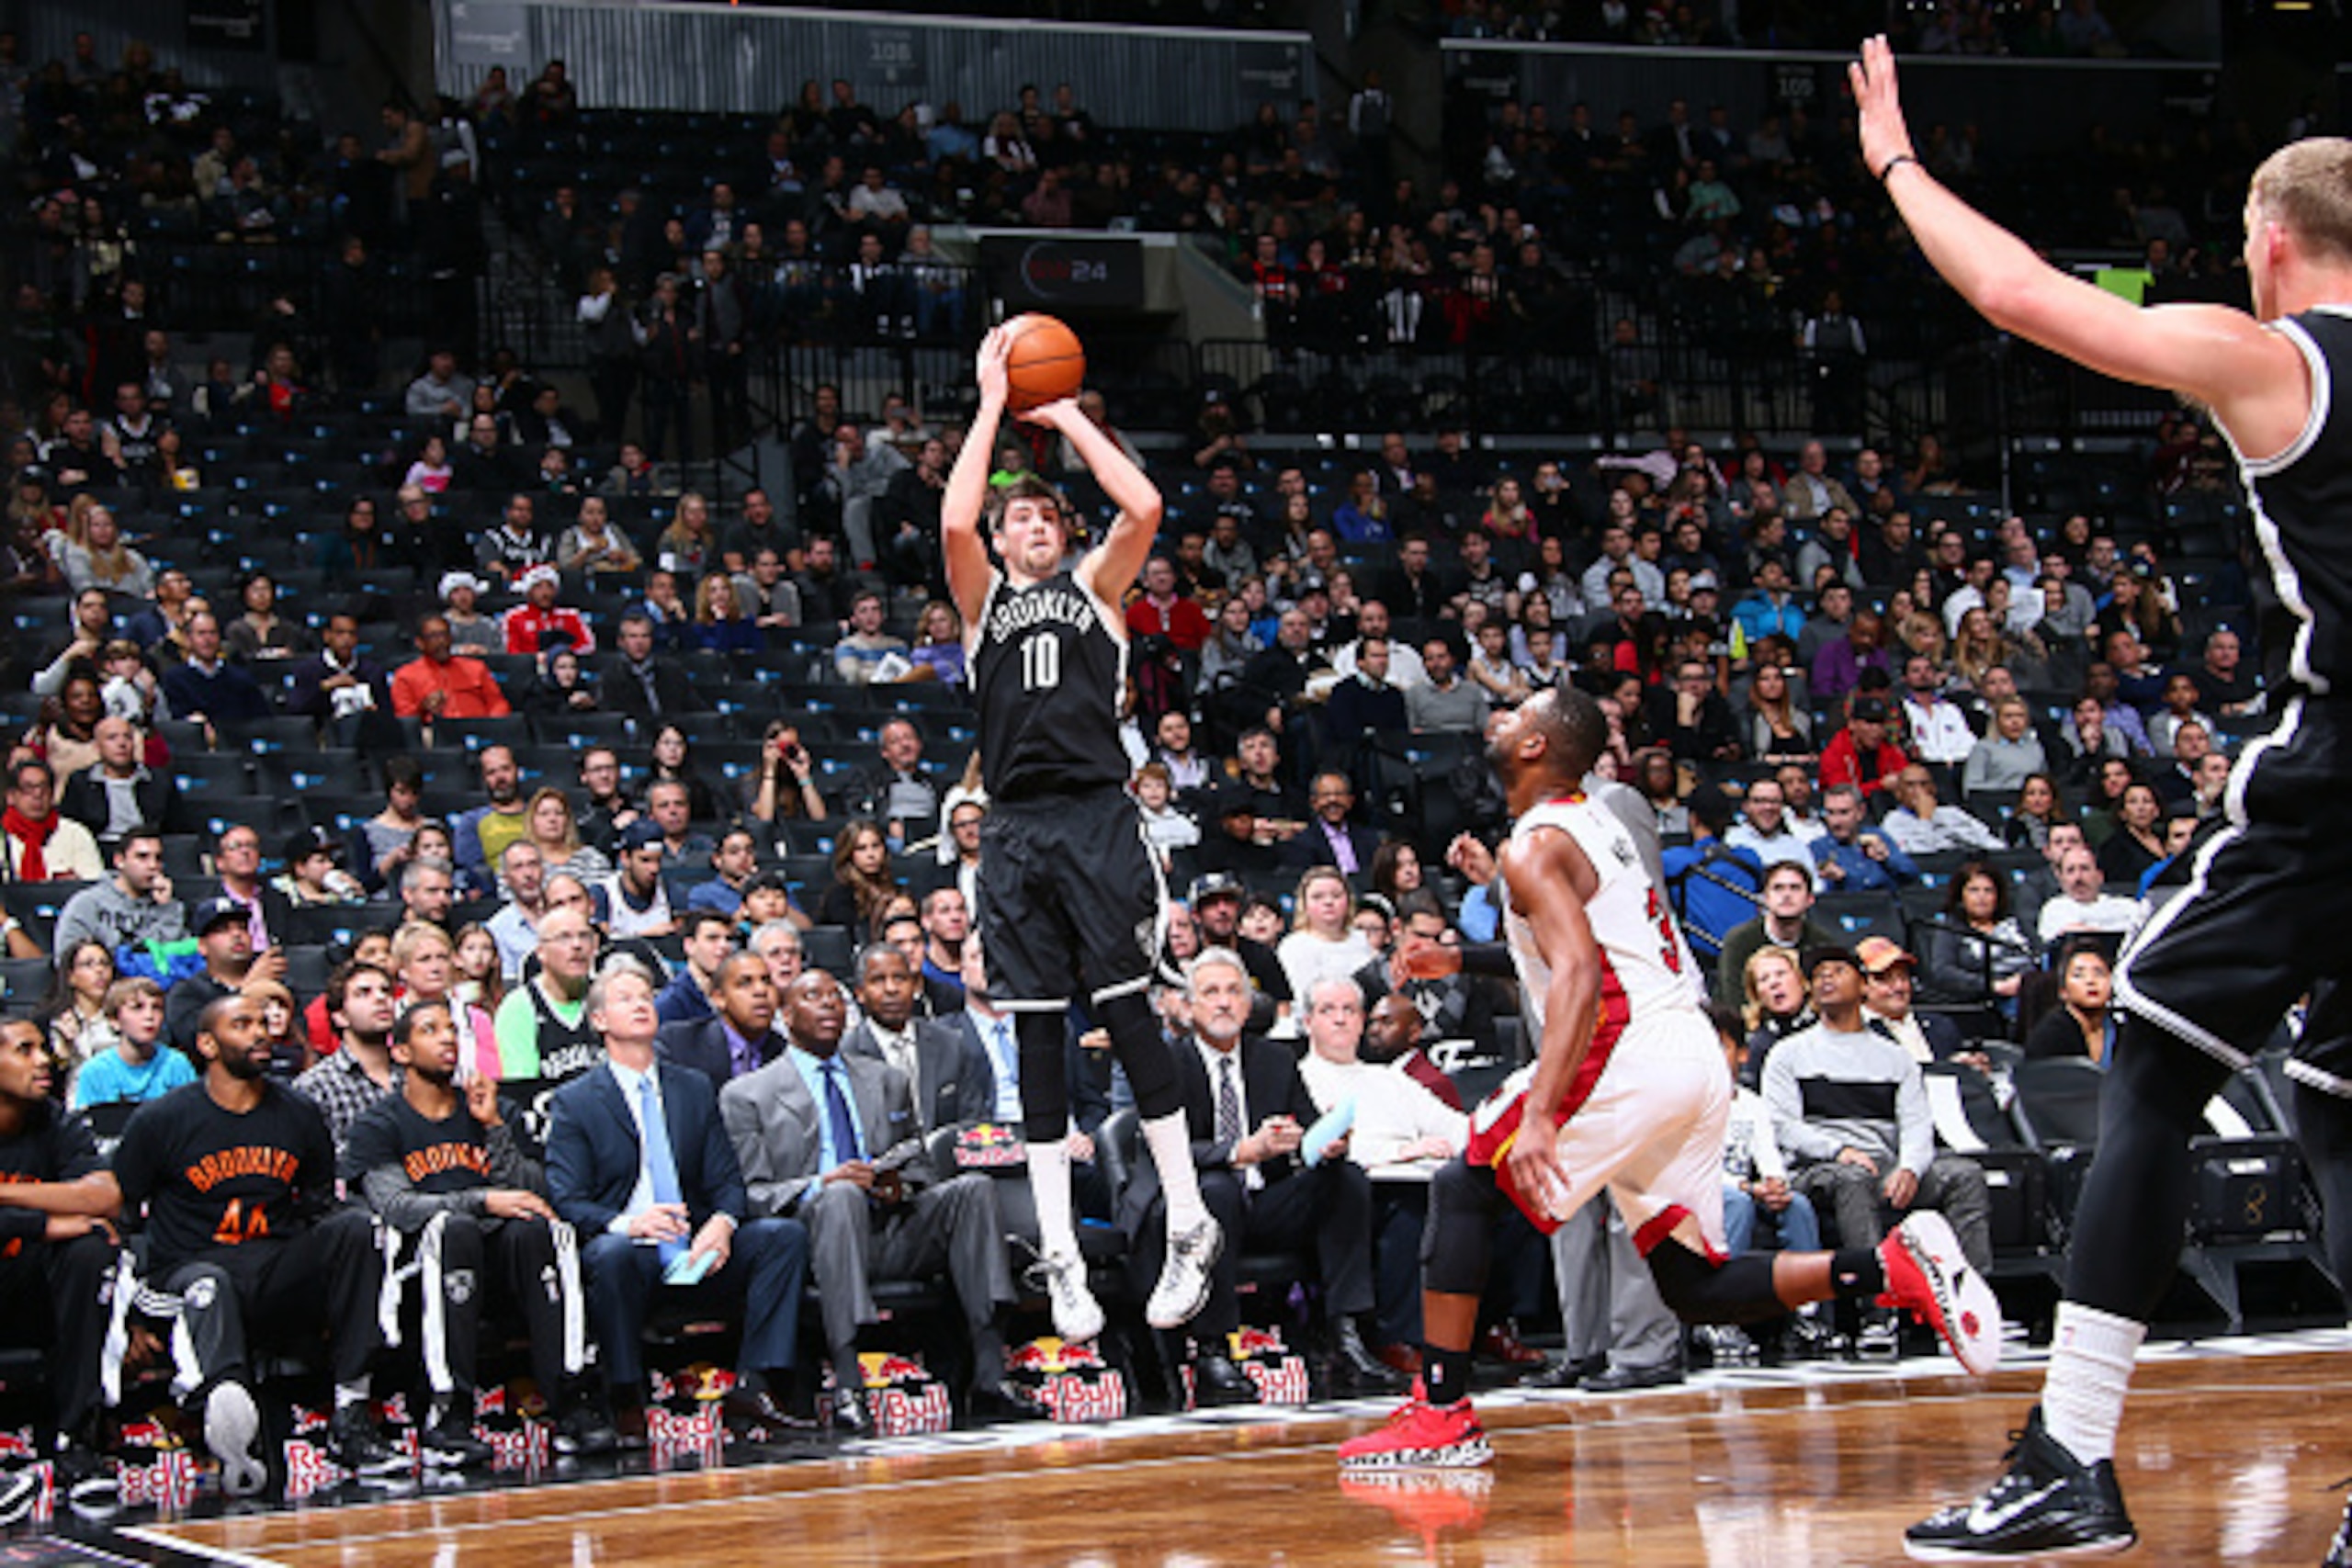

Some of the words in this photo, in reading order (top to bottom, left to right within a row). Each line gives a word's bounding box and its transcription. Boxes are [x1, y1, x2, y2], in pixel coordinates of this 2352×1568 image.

[989, 588, 1094, 643] BROOKLYN
[1020, 632, 1059, 690] 10
[1646, 886, 1679, 974] 3
[184, 1145, 300, 1193] BROOKLYN
[954, 1145, 989, 1166] Red
[991, 1141, 1025, 1165] Bull
[1061, 1370, 1124, 1405] Bull
[1242, 1356, 1307, 1393] Bull
[883, 1383, 951, 1419] Bull
[647, 1403, 714, 1440] Red
